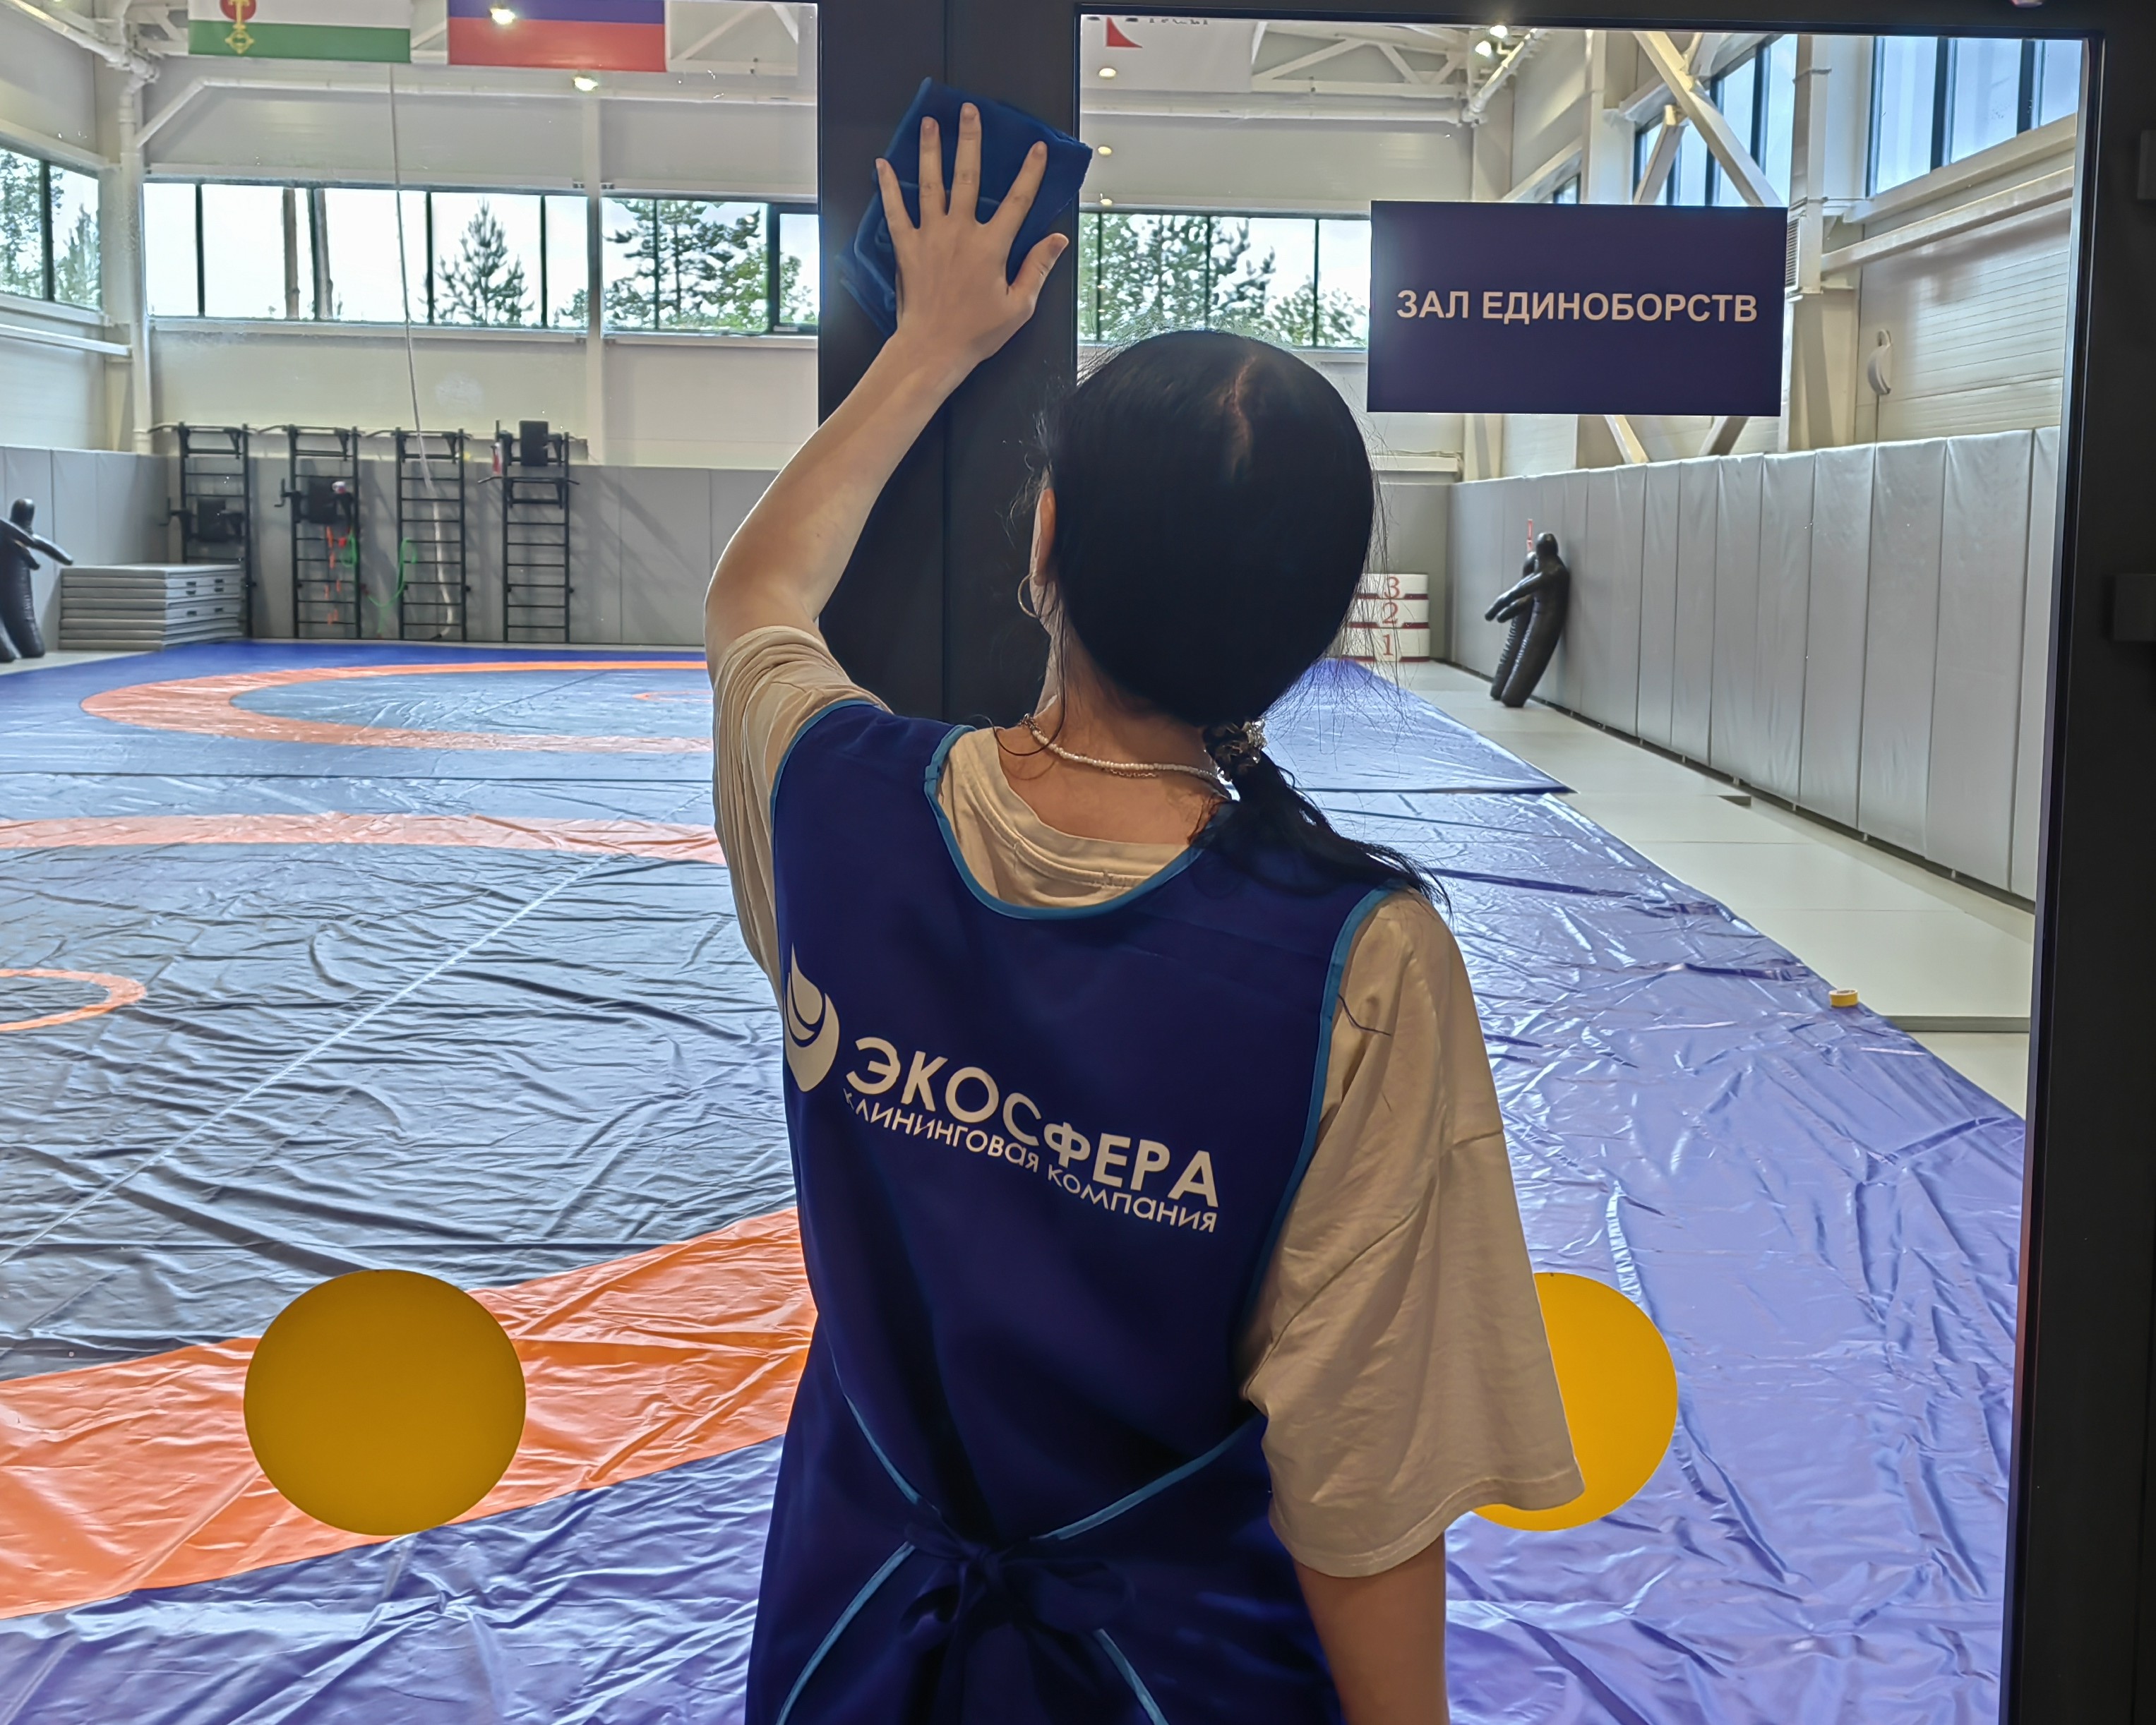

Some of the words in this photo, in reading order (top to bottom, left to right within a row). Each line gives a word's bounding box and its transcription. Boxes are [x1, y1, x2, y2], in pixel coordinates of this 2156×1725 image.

[1396, 289, 1469, 318] ЗАЛ
[1483, 291, 1757, 325] ЕДИНОБОРСТВ
[1384, 576, 1401, 599] 3
[1382, 601, 1399, 624] 2
[1382, 634, 1394, 656] 1
[846, 1036, 1218, 1208] ЭКОСФЕРА
